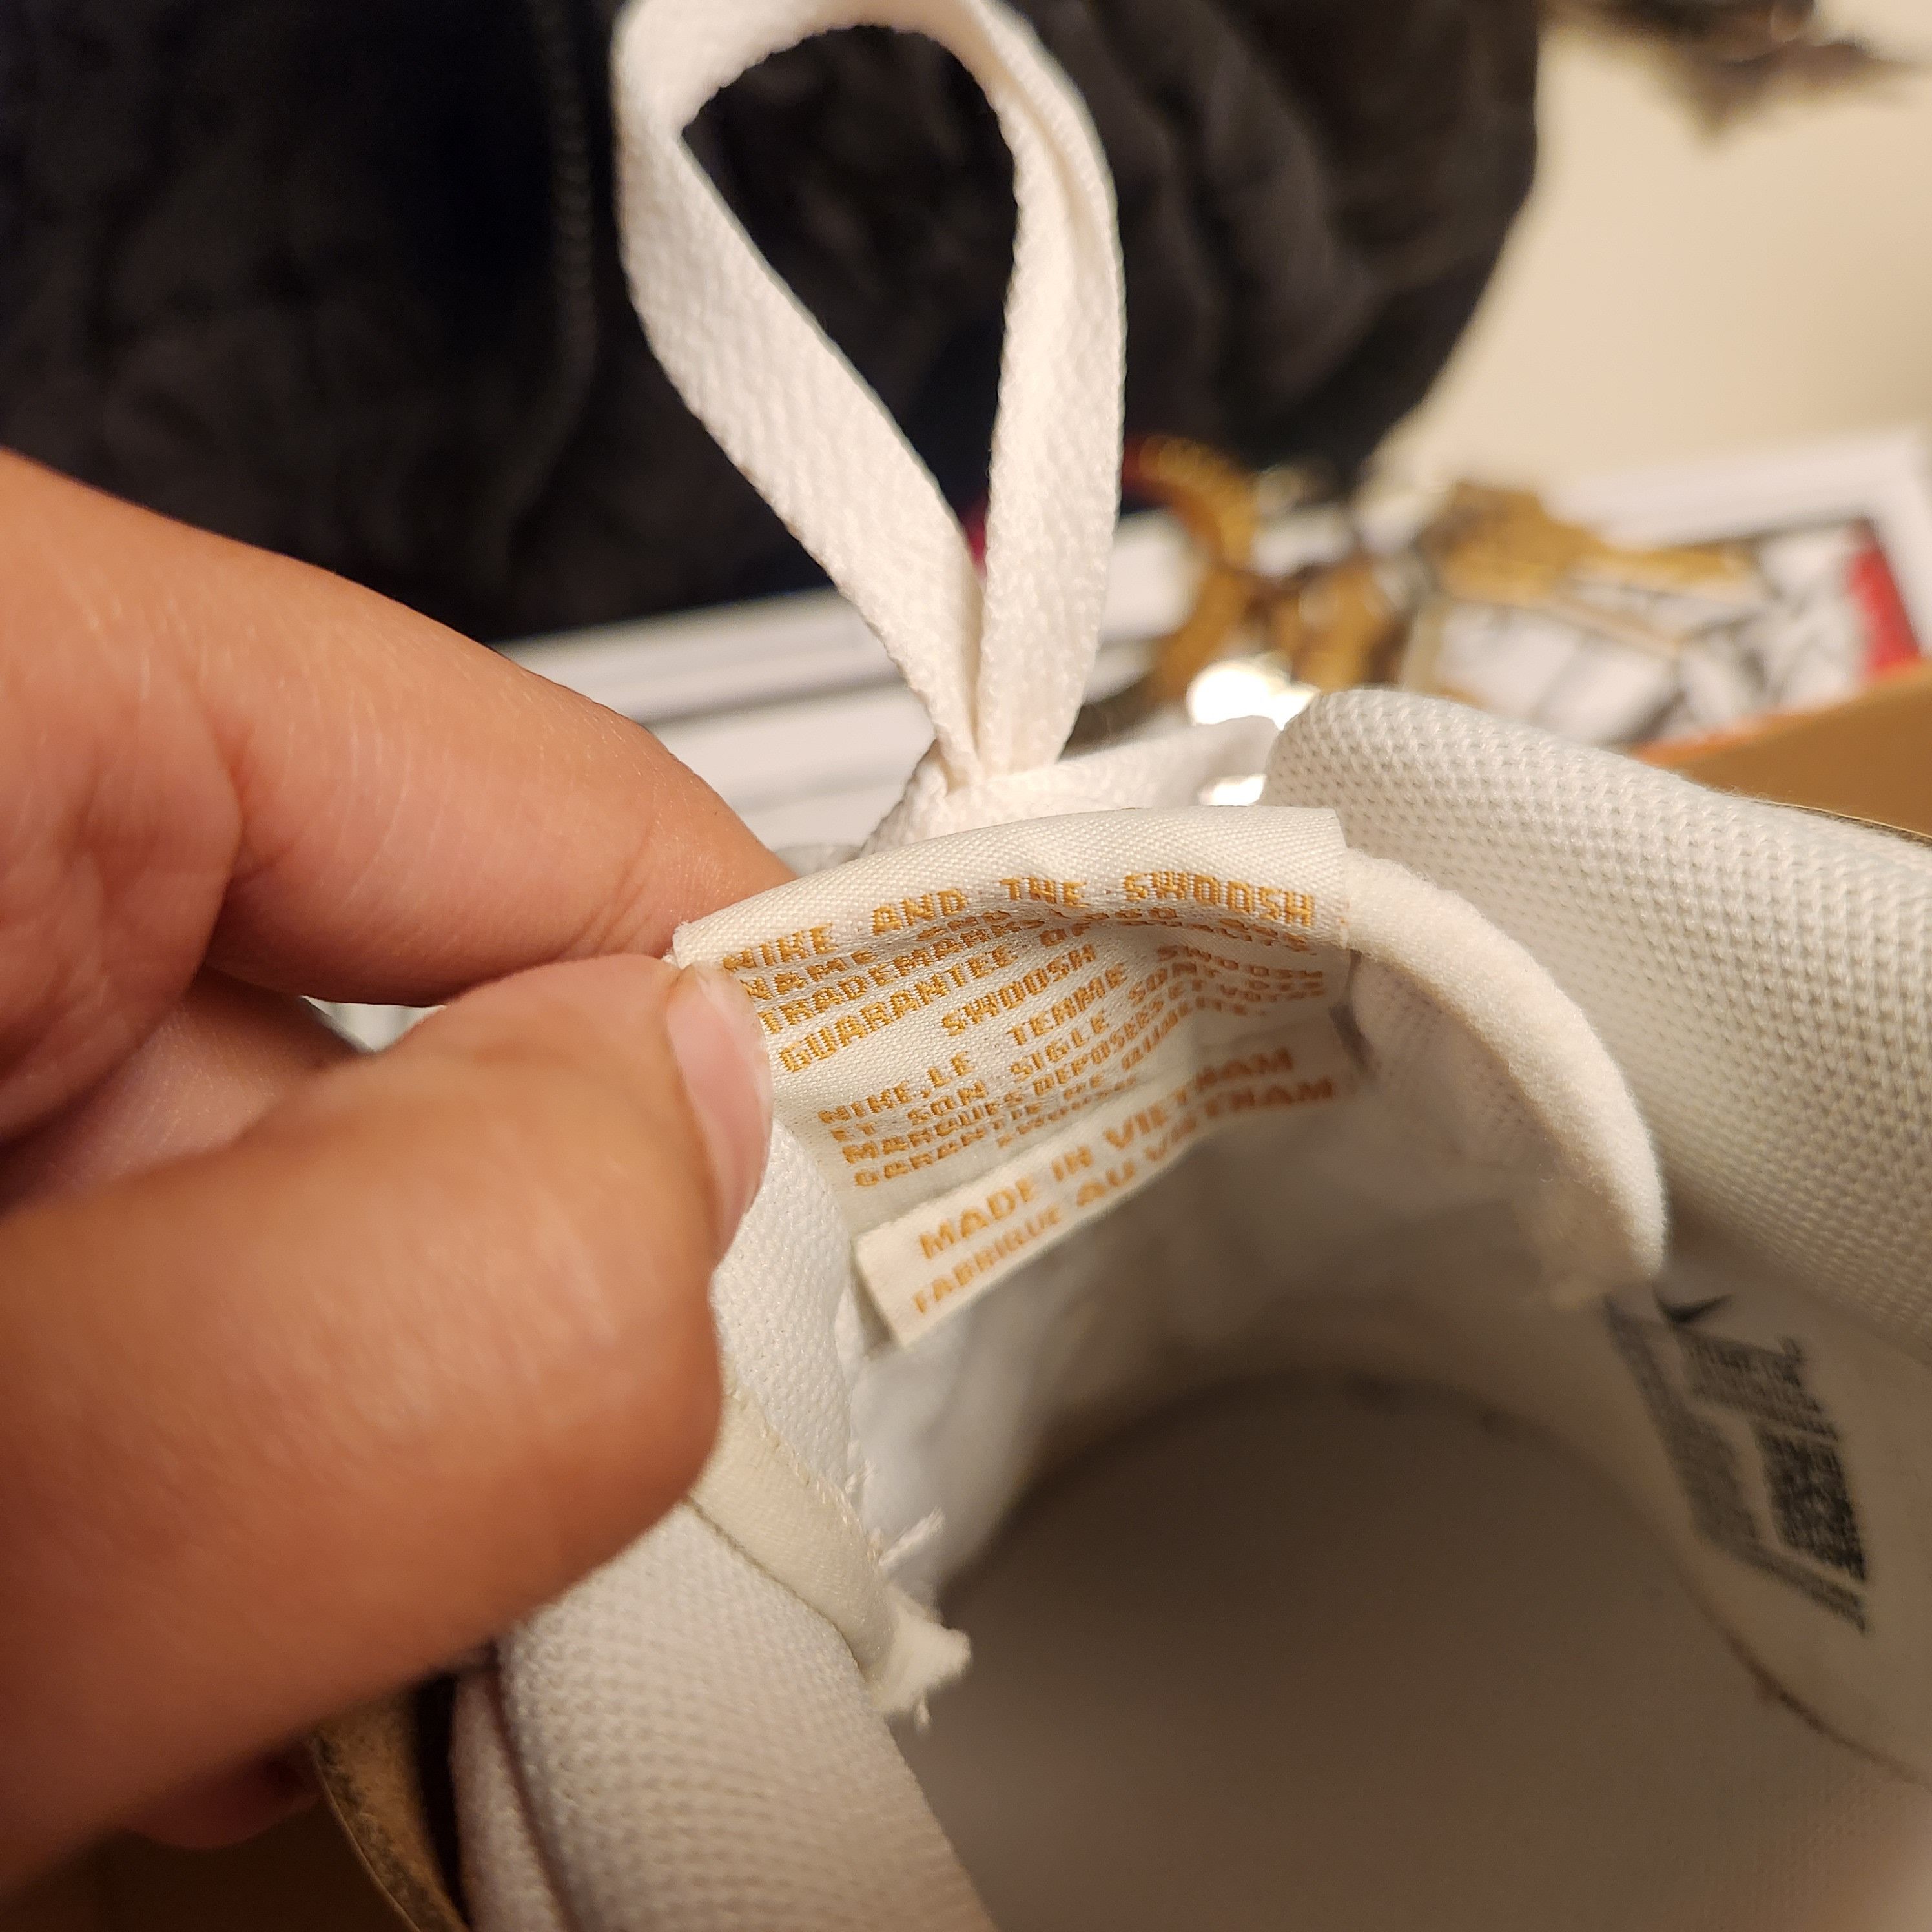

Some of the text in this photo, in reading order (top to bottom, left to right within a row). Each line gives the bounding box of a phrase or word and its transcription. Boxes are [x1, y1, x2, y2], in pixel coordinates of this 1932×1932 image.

[872, 887, 968, 936] AND
[1000, 877, 1088, 907] THE
[1123, 871, 1313, 926] SWOOSH
[779, 945, 1018, 1072] GUARANTEE
[941, 943, 1096, 1036] SWOOSH
[907, 1079, 989, 1126] SON
[1010, 1009, 1109, 1082] SIGLE
[920, 1177, 1035, 1262] MADE
[1053, 1146, 1094, 1182] IN
[1103, 1046, 1294, 1149] VIETNAM
[1076, 1160, 1135, 1207] AU
